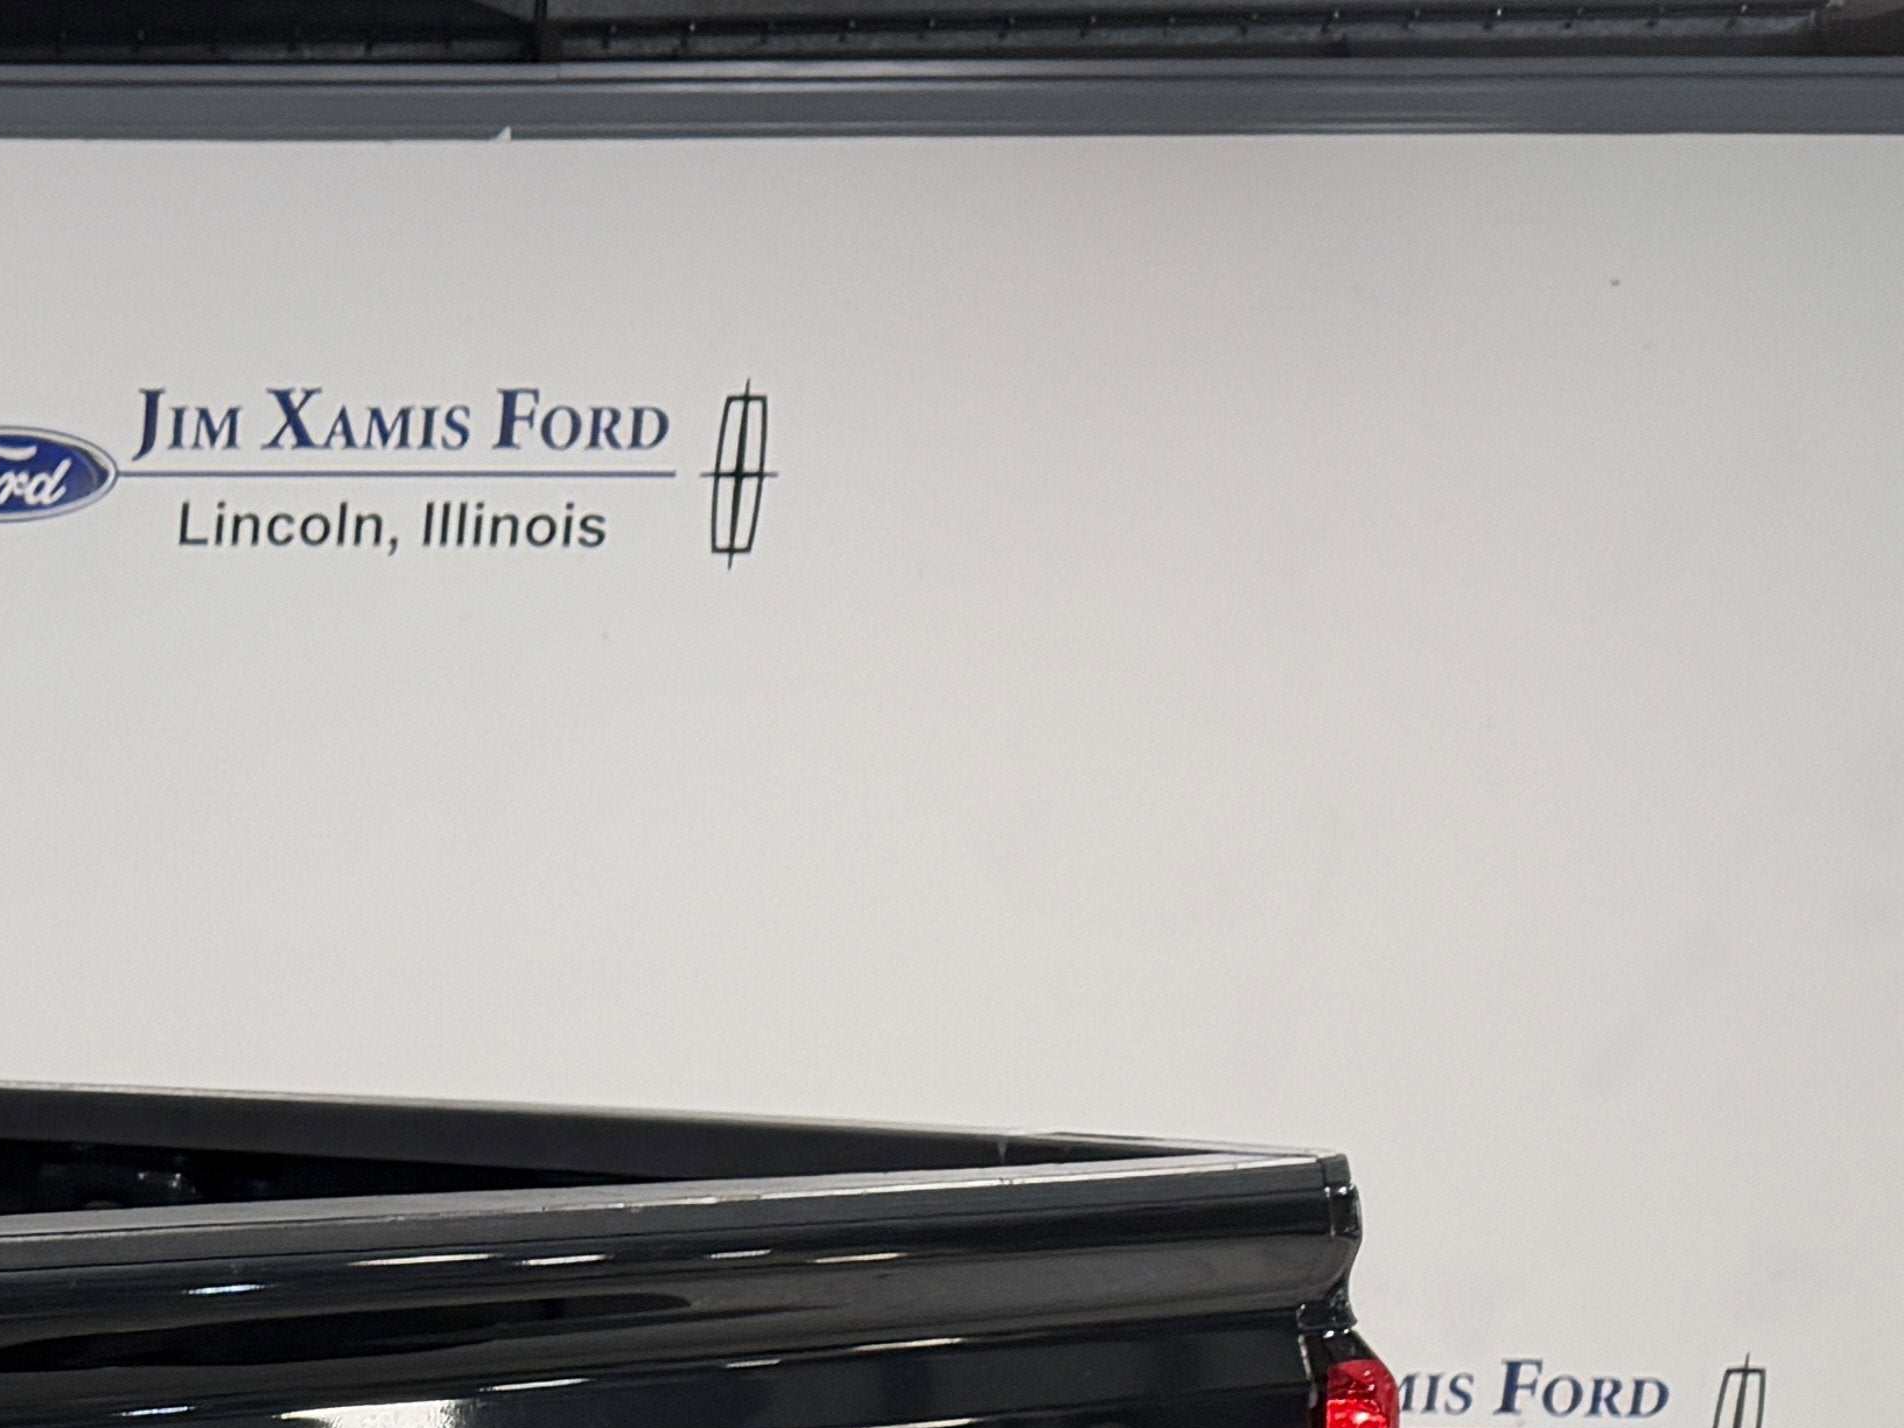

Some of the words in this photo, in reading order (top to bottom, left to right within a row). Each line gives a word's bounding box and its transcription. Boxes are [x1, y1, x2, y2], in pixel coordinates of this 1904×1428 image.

[131, 387, 241, 460] JIM
[264, 387, 471, 451] XAMIS
[492, 388, 671, 451] FORD
[177, 500, 399, 556] Lincoln,
[421, 502, 608, 548] Illinois
[1491, 1357, 1672, 1419] FORD
